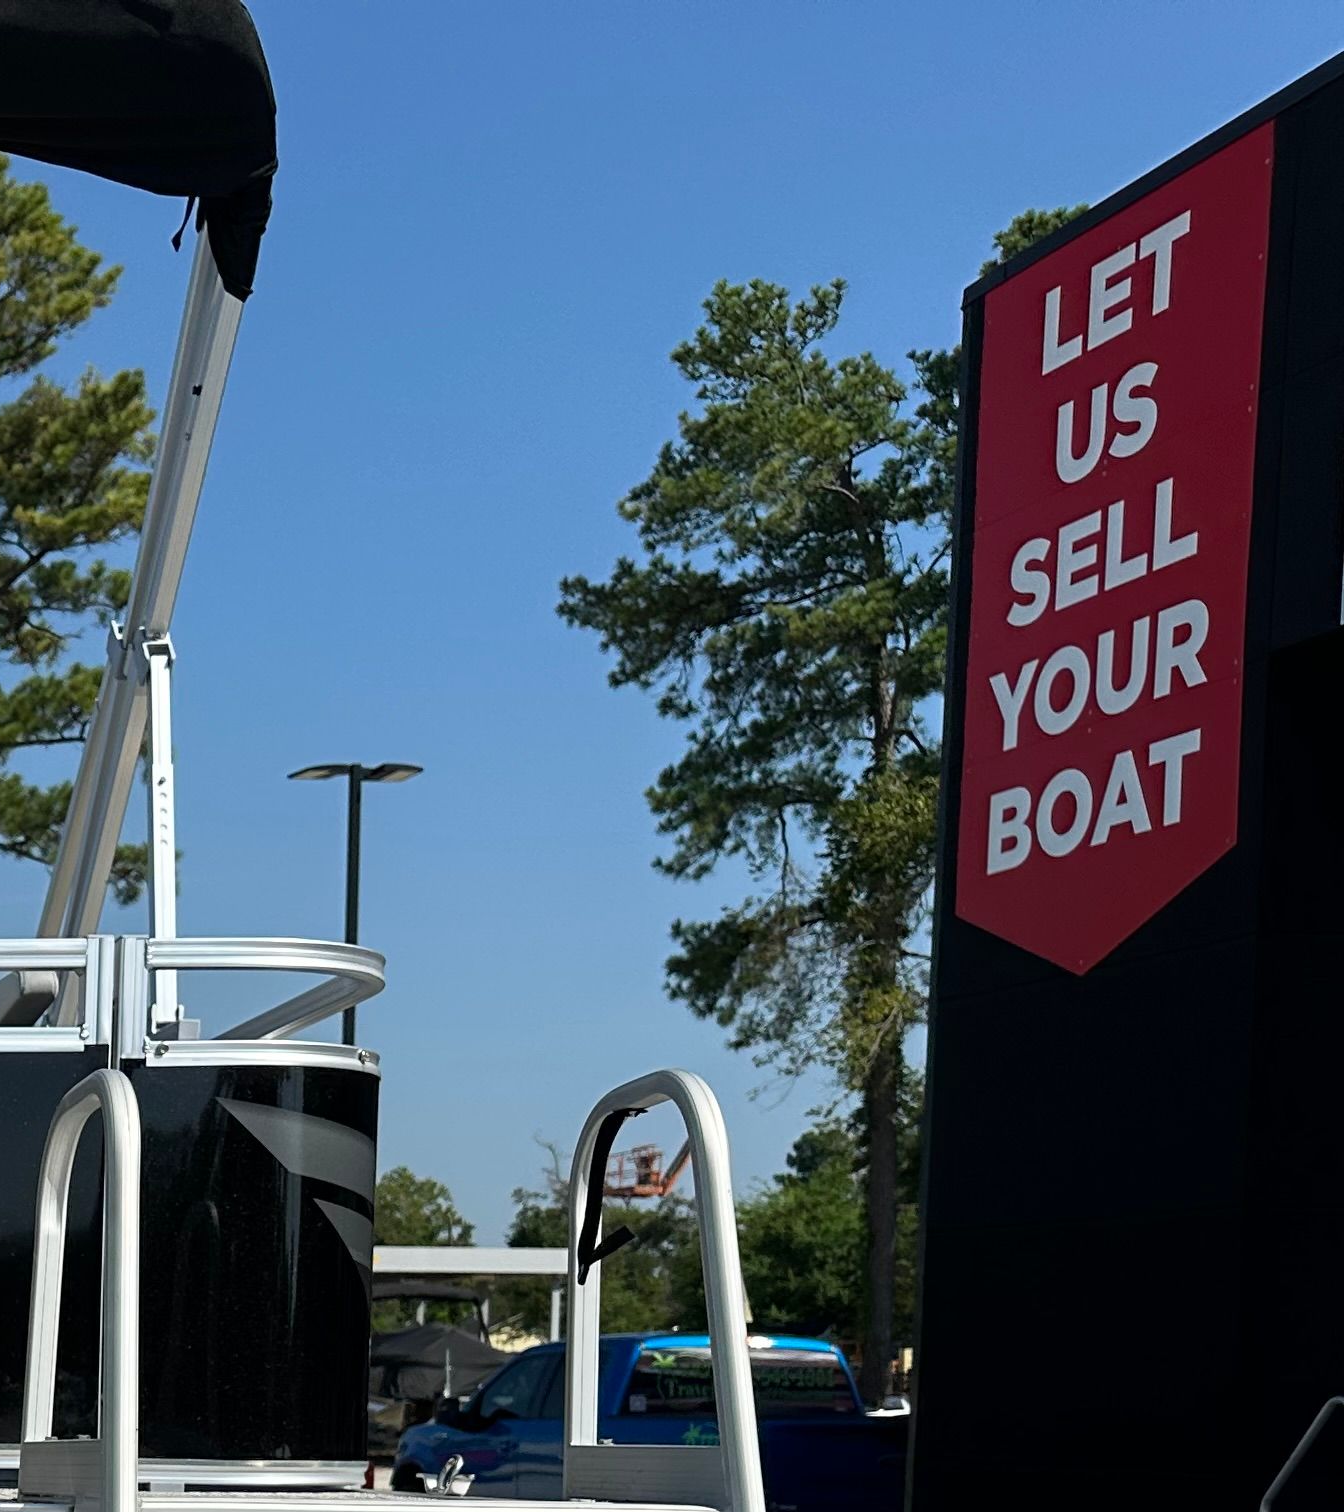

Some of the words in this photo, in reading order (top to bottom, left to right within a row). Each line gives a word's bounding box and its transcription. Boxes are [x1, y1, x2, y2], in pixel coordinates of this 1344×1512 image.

[1041, 210, 1192, 376] LET
[1055, 361, 1159, 485] US
[1006, 476, 1200, 628] SELL
[989, 598, 1210, 751] YOUR
[986, 727, 1204, 876] BOAT
